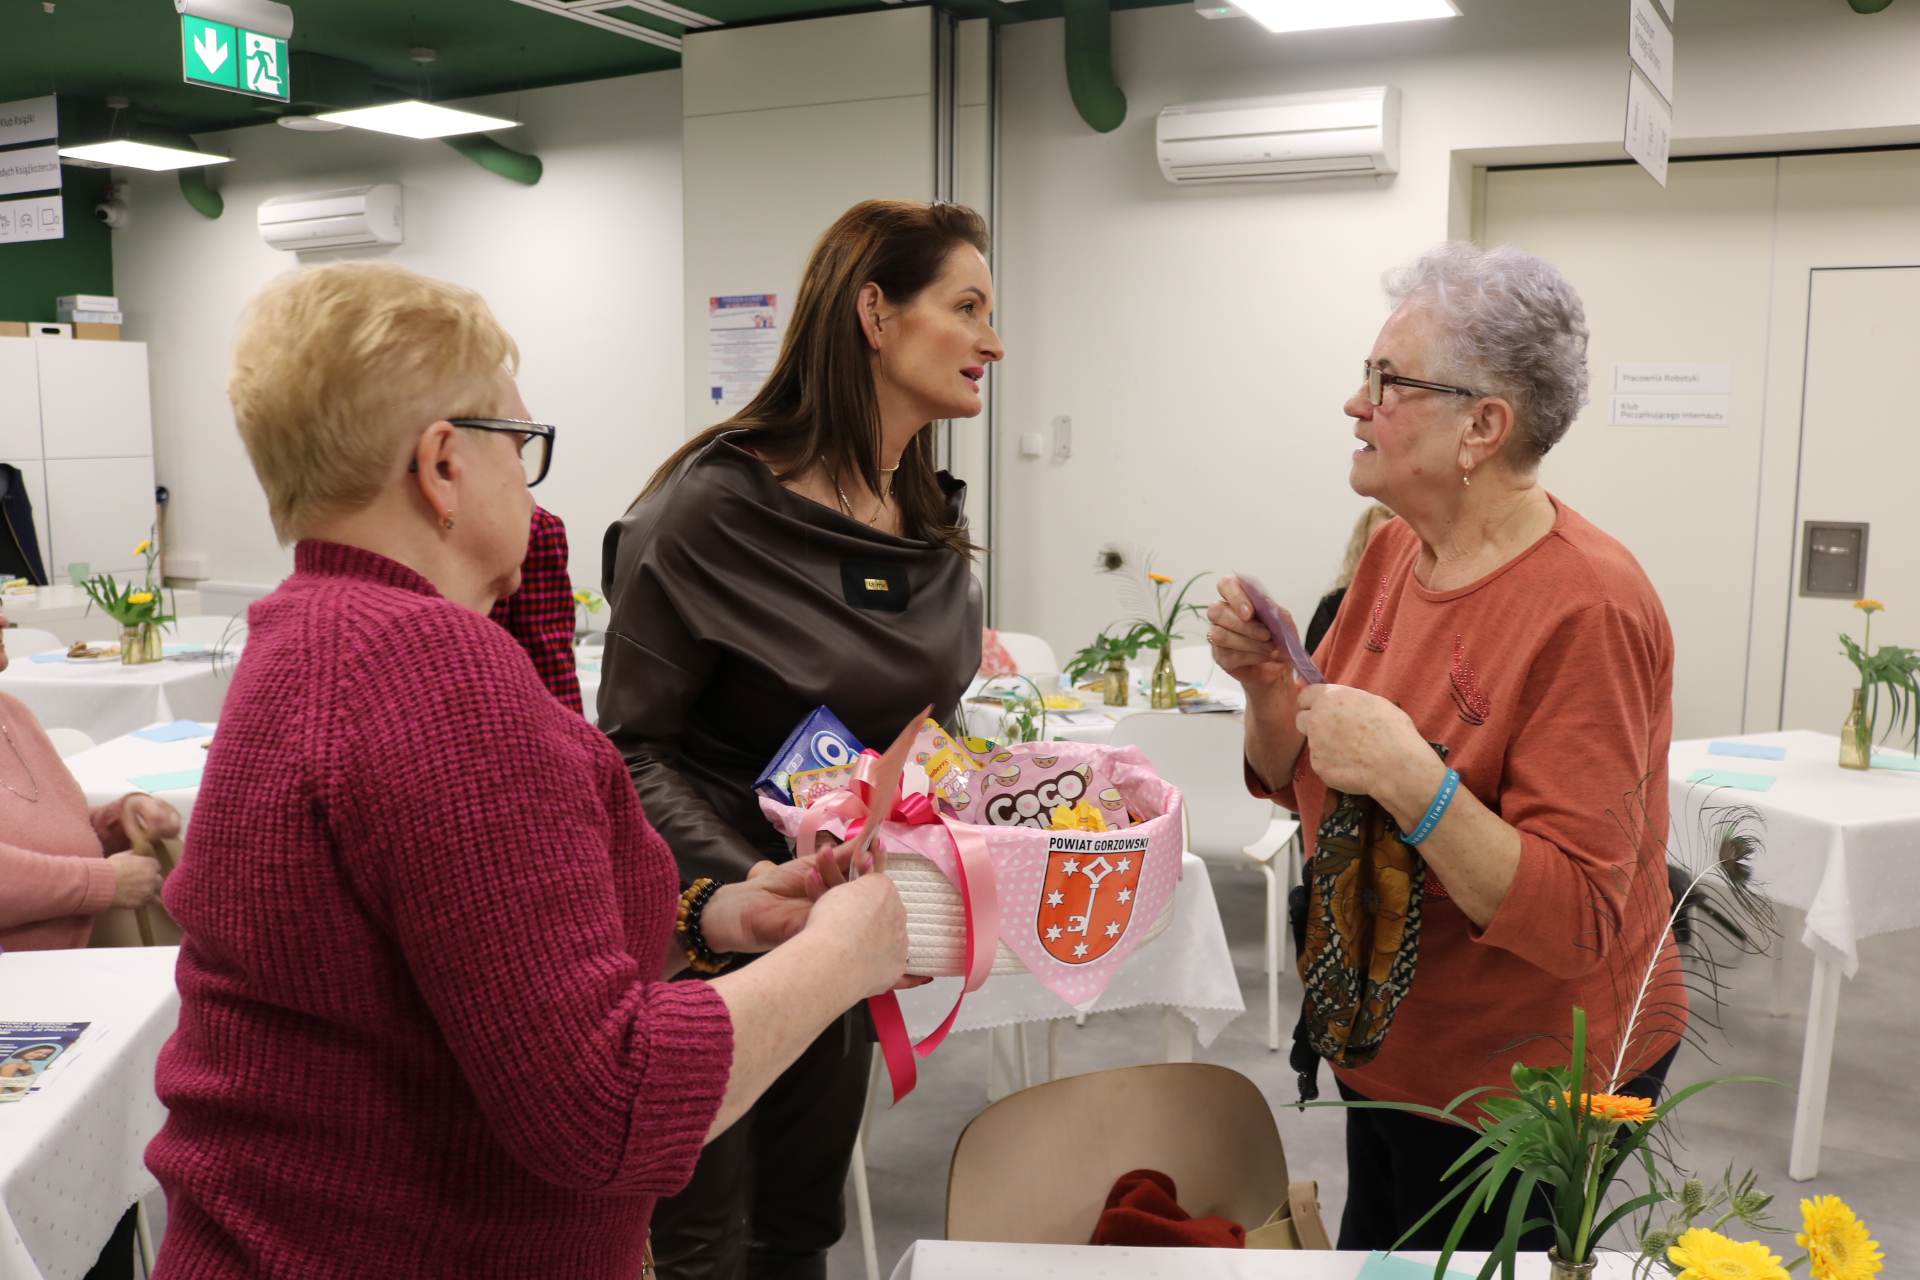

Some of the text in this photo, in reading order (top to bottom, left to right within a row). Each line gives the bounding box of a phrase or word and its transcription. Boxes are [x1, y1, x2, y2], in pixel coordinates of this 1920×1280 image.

[1622, 374, 1700, 384] Pracownia Robotyki
[1621, 403, 1639, 411] Klub
[1620, 411, 1724, 421] Początkującego Internauty
[1049, 837, 1149, 851] POWIAT GORZOWSKI
